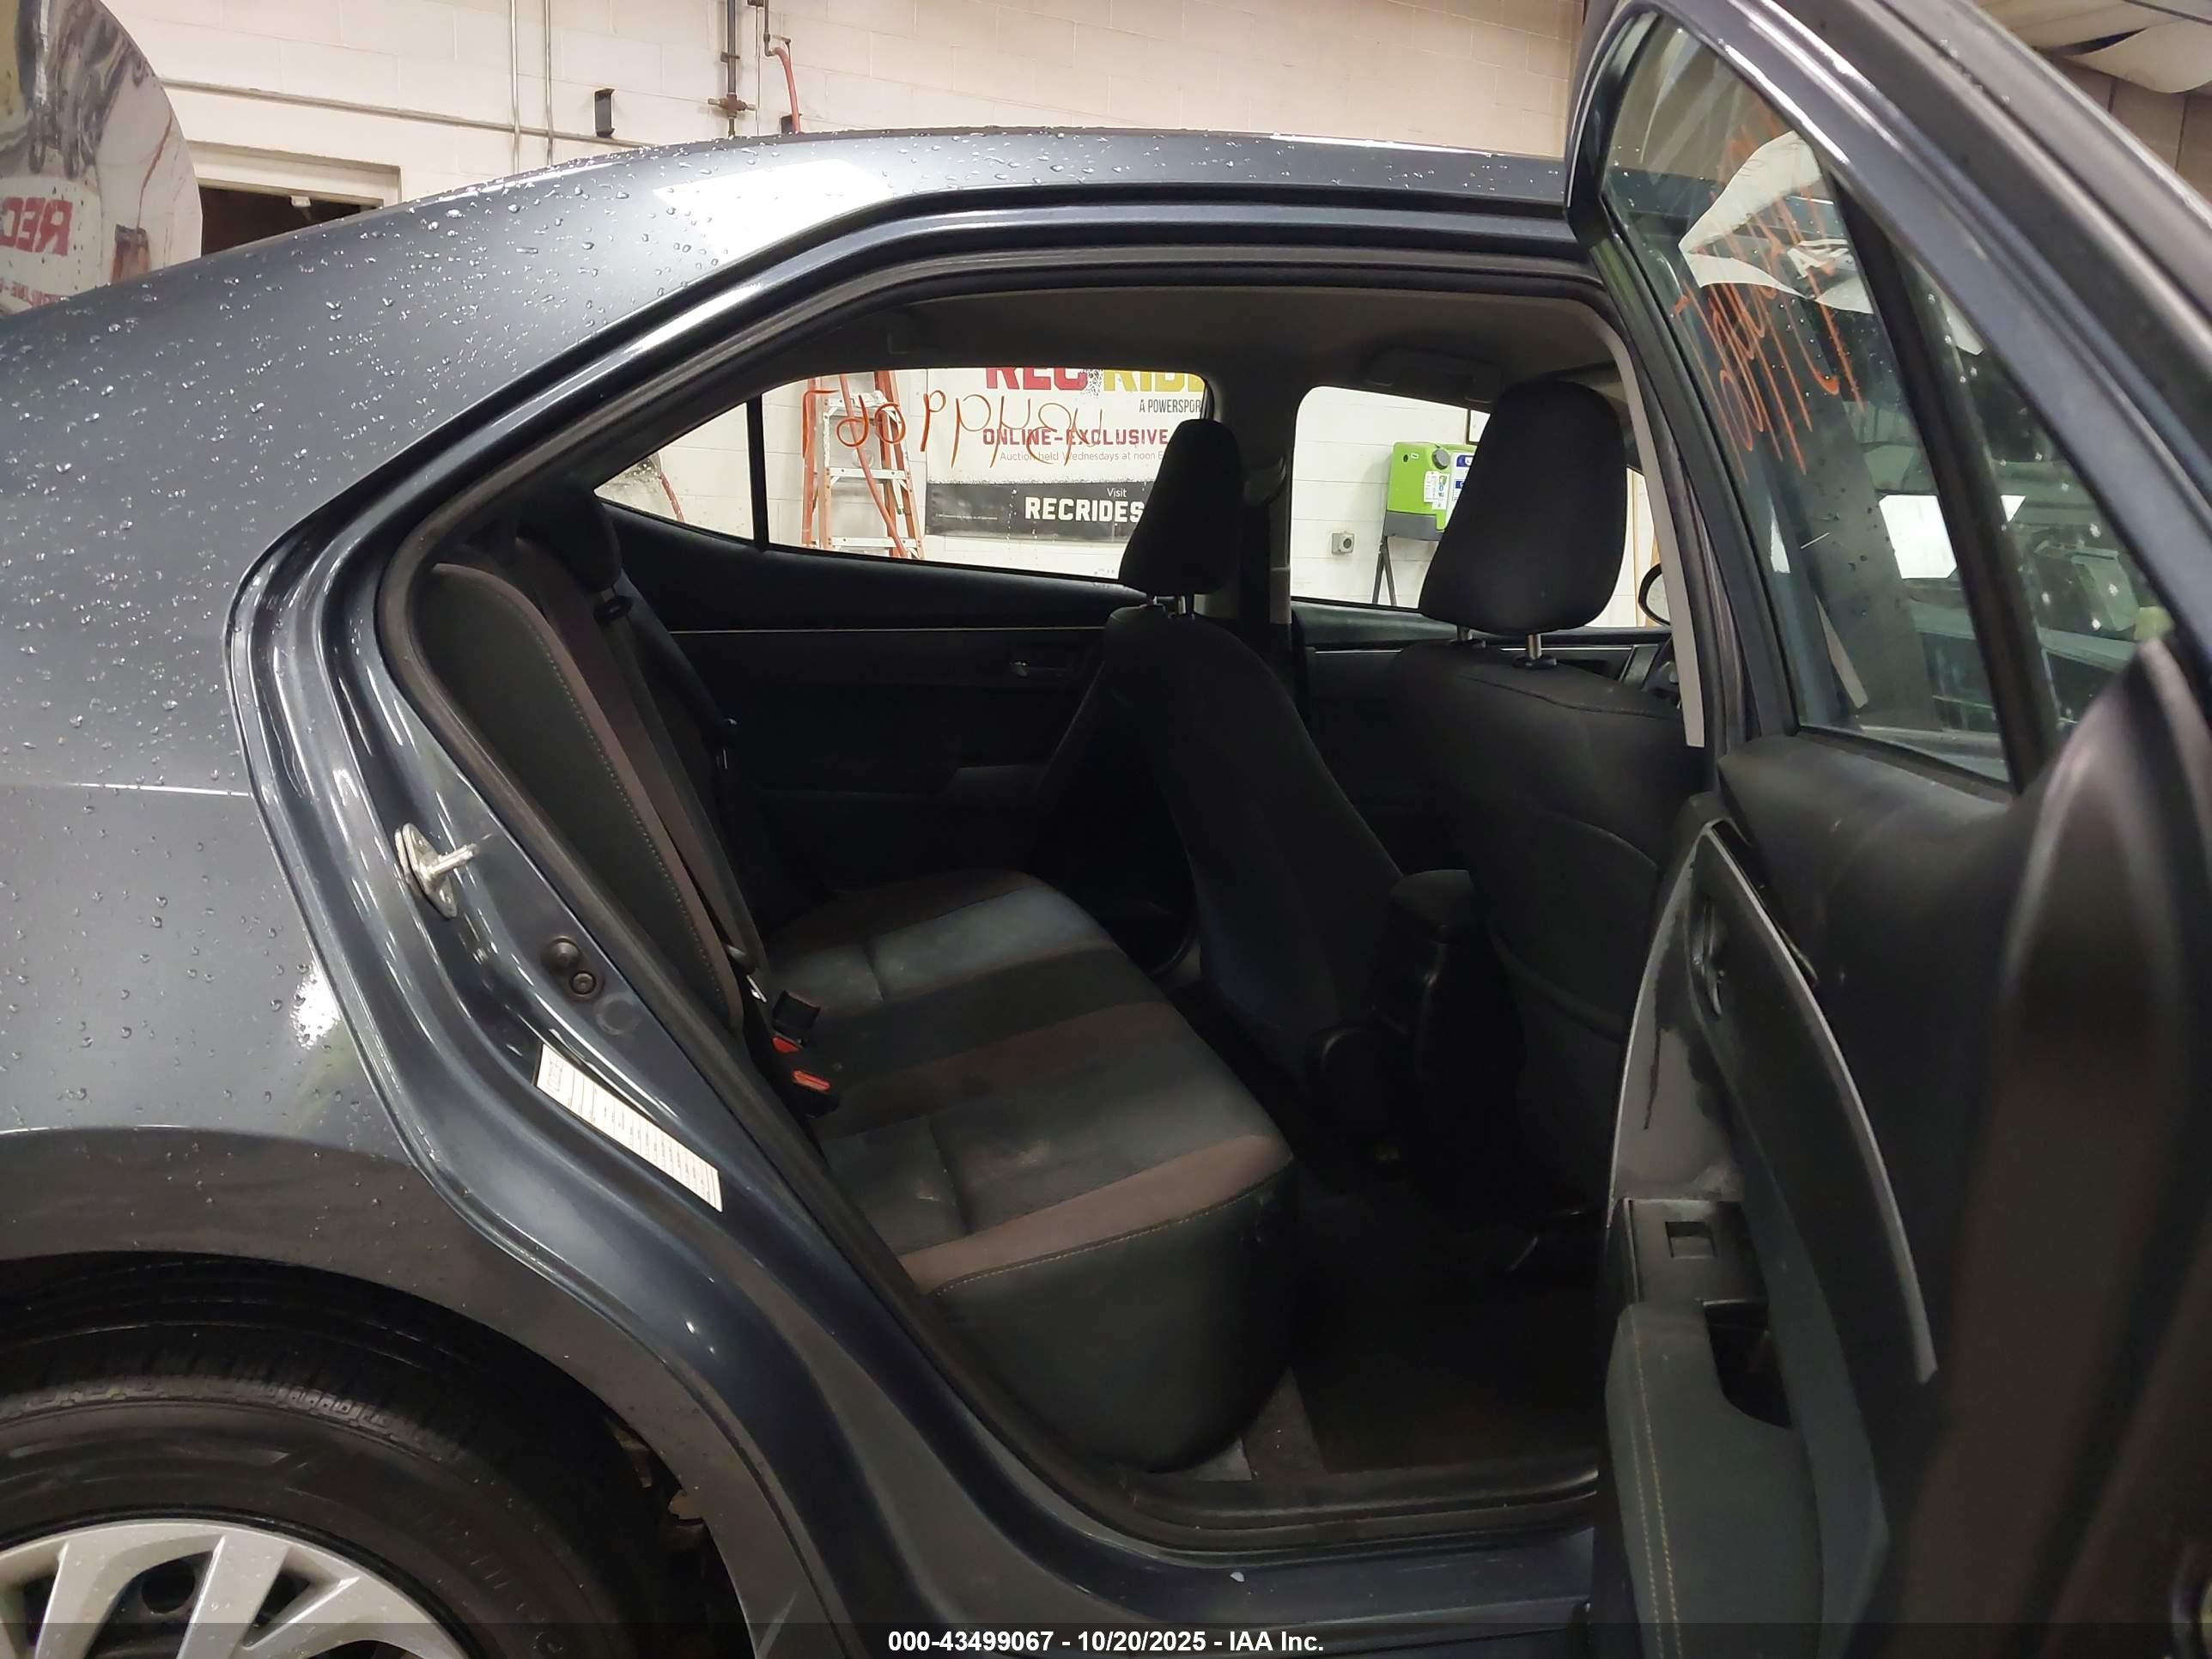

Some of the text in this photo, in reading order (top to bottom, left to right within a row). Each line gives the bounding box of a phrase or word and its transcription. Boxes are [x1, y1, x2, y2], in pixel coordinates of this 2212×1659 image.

[1139, 399, 1146, 413] A
[1039, 452, 1059, 461] held
[1122, 452, 1131, 460] at
[1133, 453, 1156, 461] noon
[1106, 488, 1127, 498] Visit
[1024, 497, 1146, 523] RECRIDES
